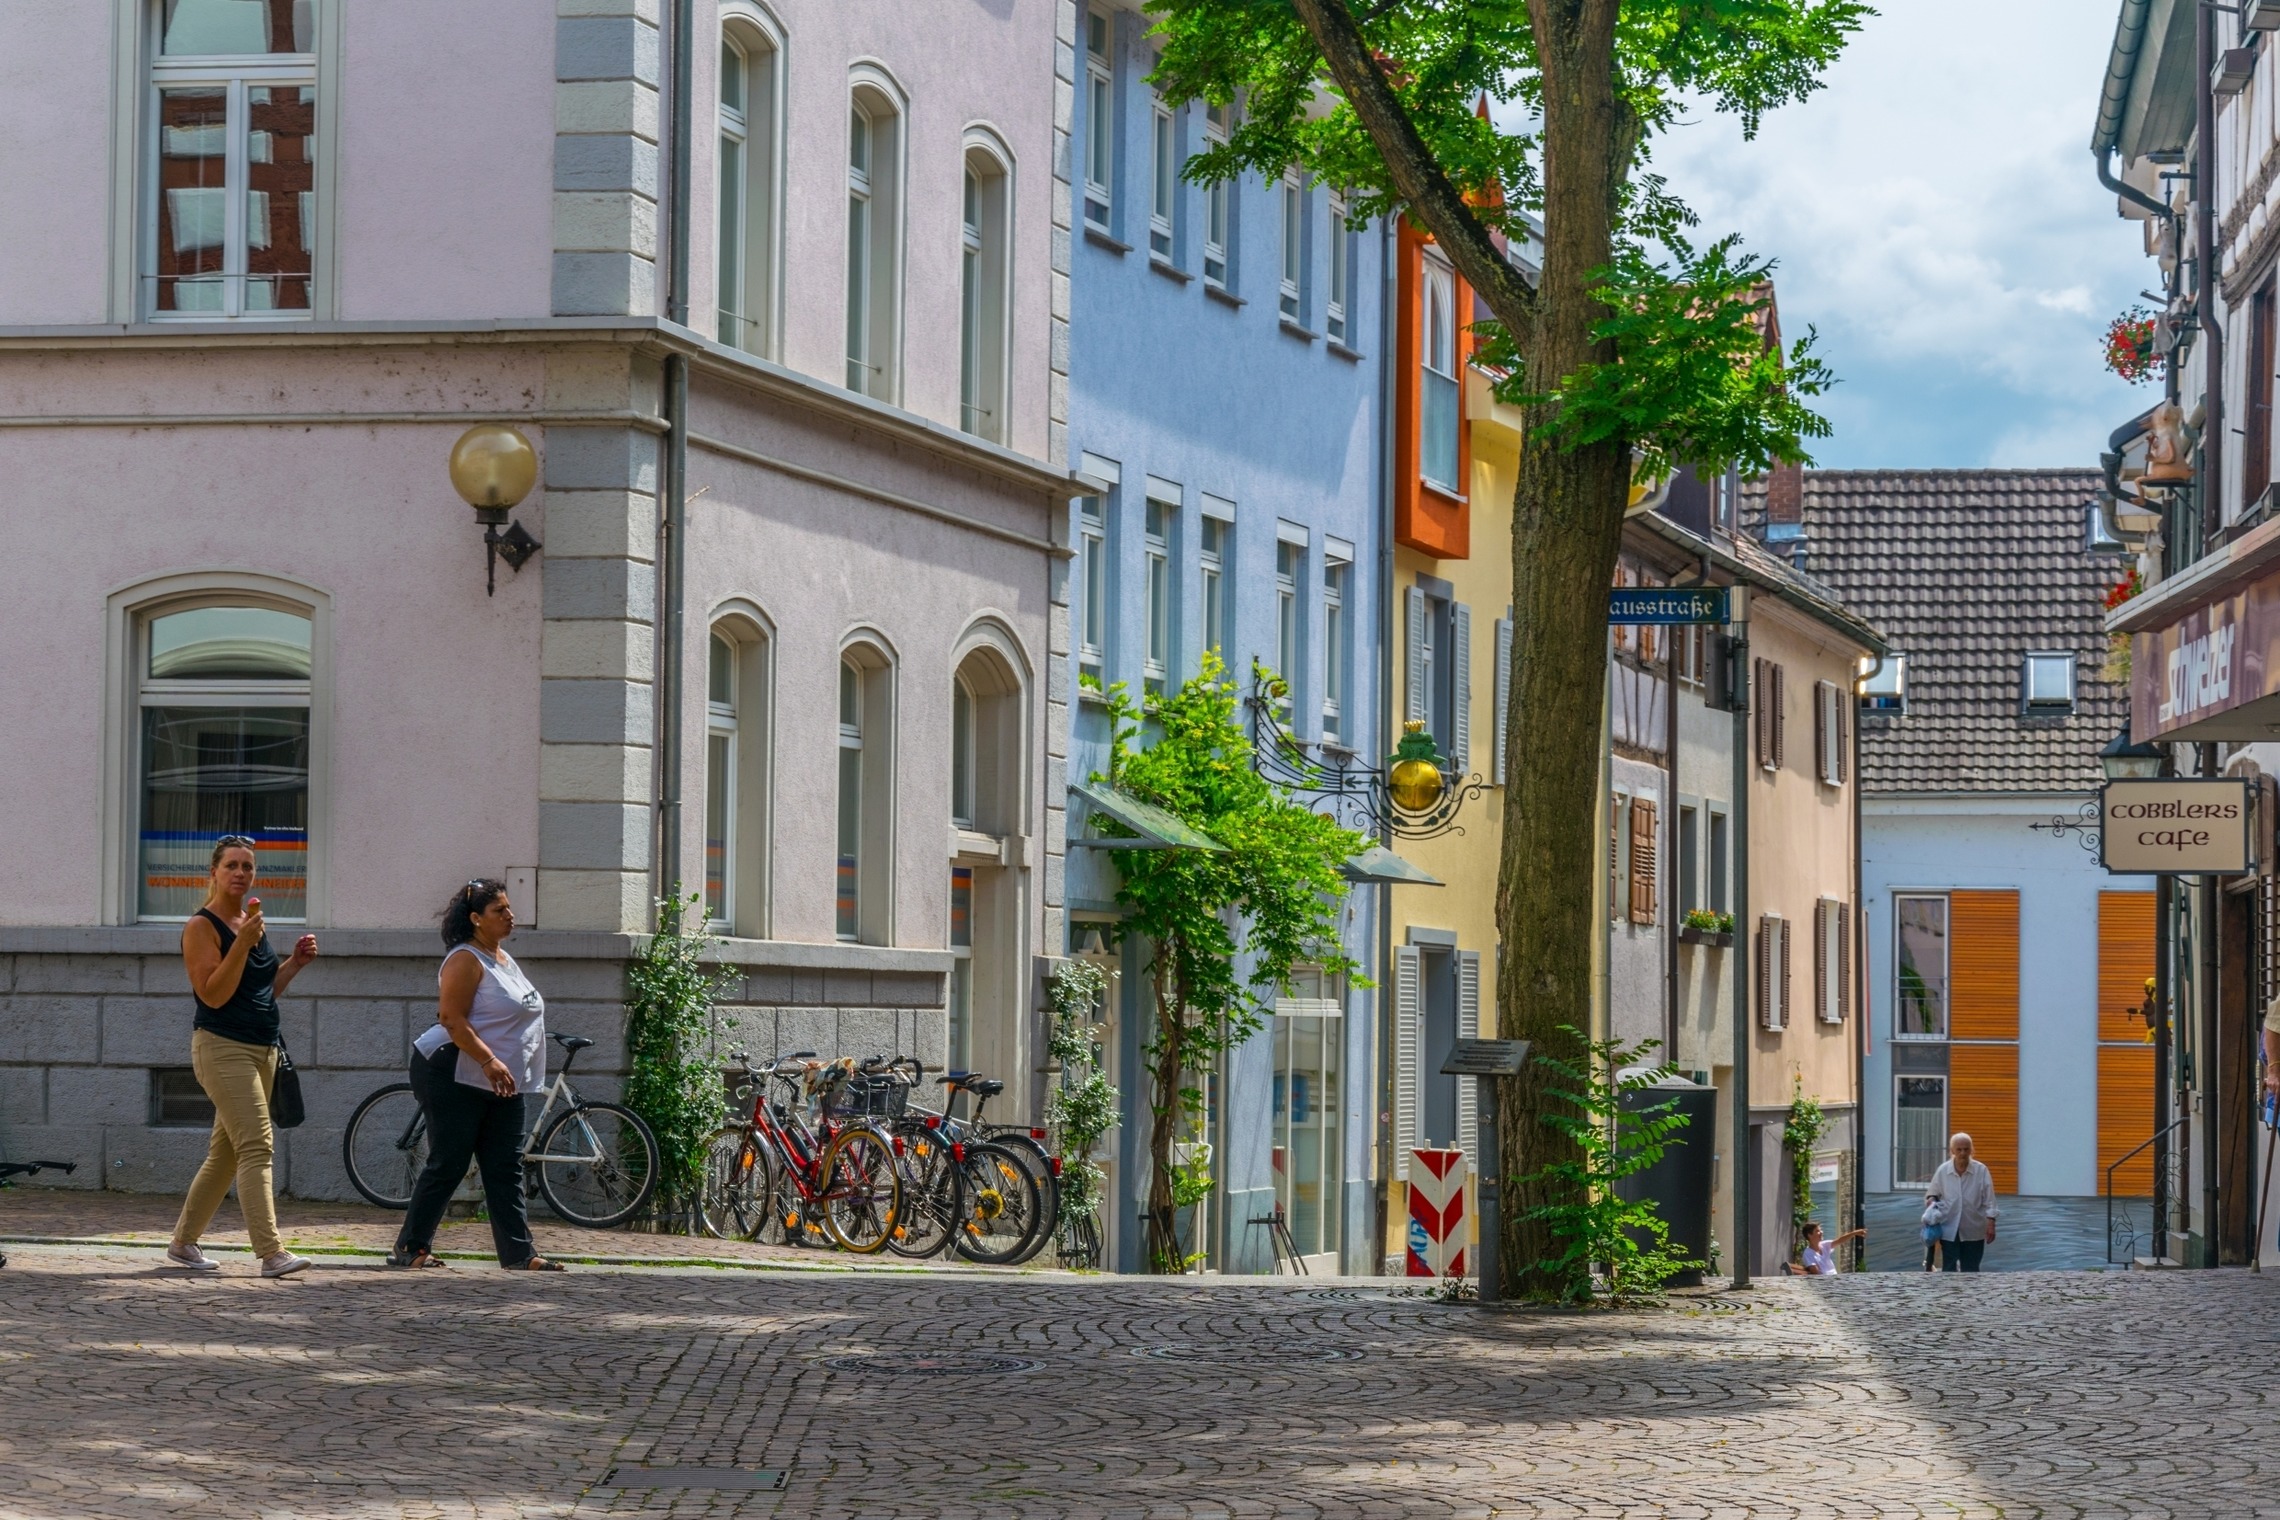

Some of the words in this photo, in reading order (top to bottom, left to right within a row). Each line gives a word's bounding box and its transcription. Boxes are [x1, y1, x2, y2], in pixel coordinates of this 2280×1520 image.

[1609, 595, 1713, 619] ausstraße
[147, 864, 211, 872] VERSICHERUNG
[256, 864, 307, 873] ANZMAKLER
